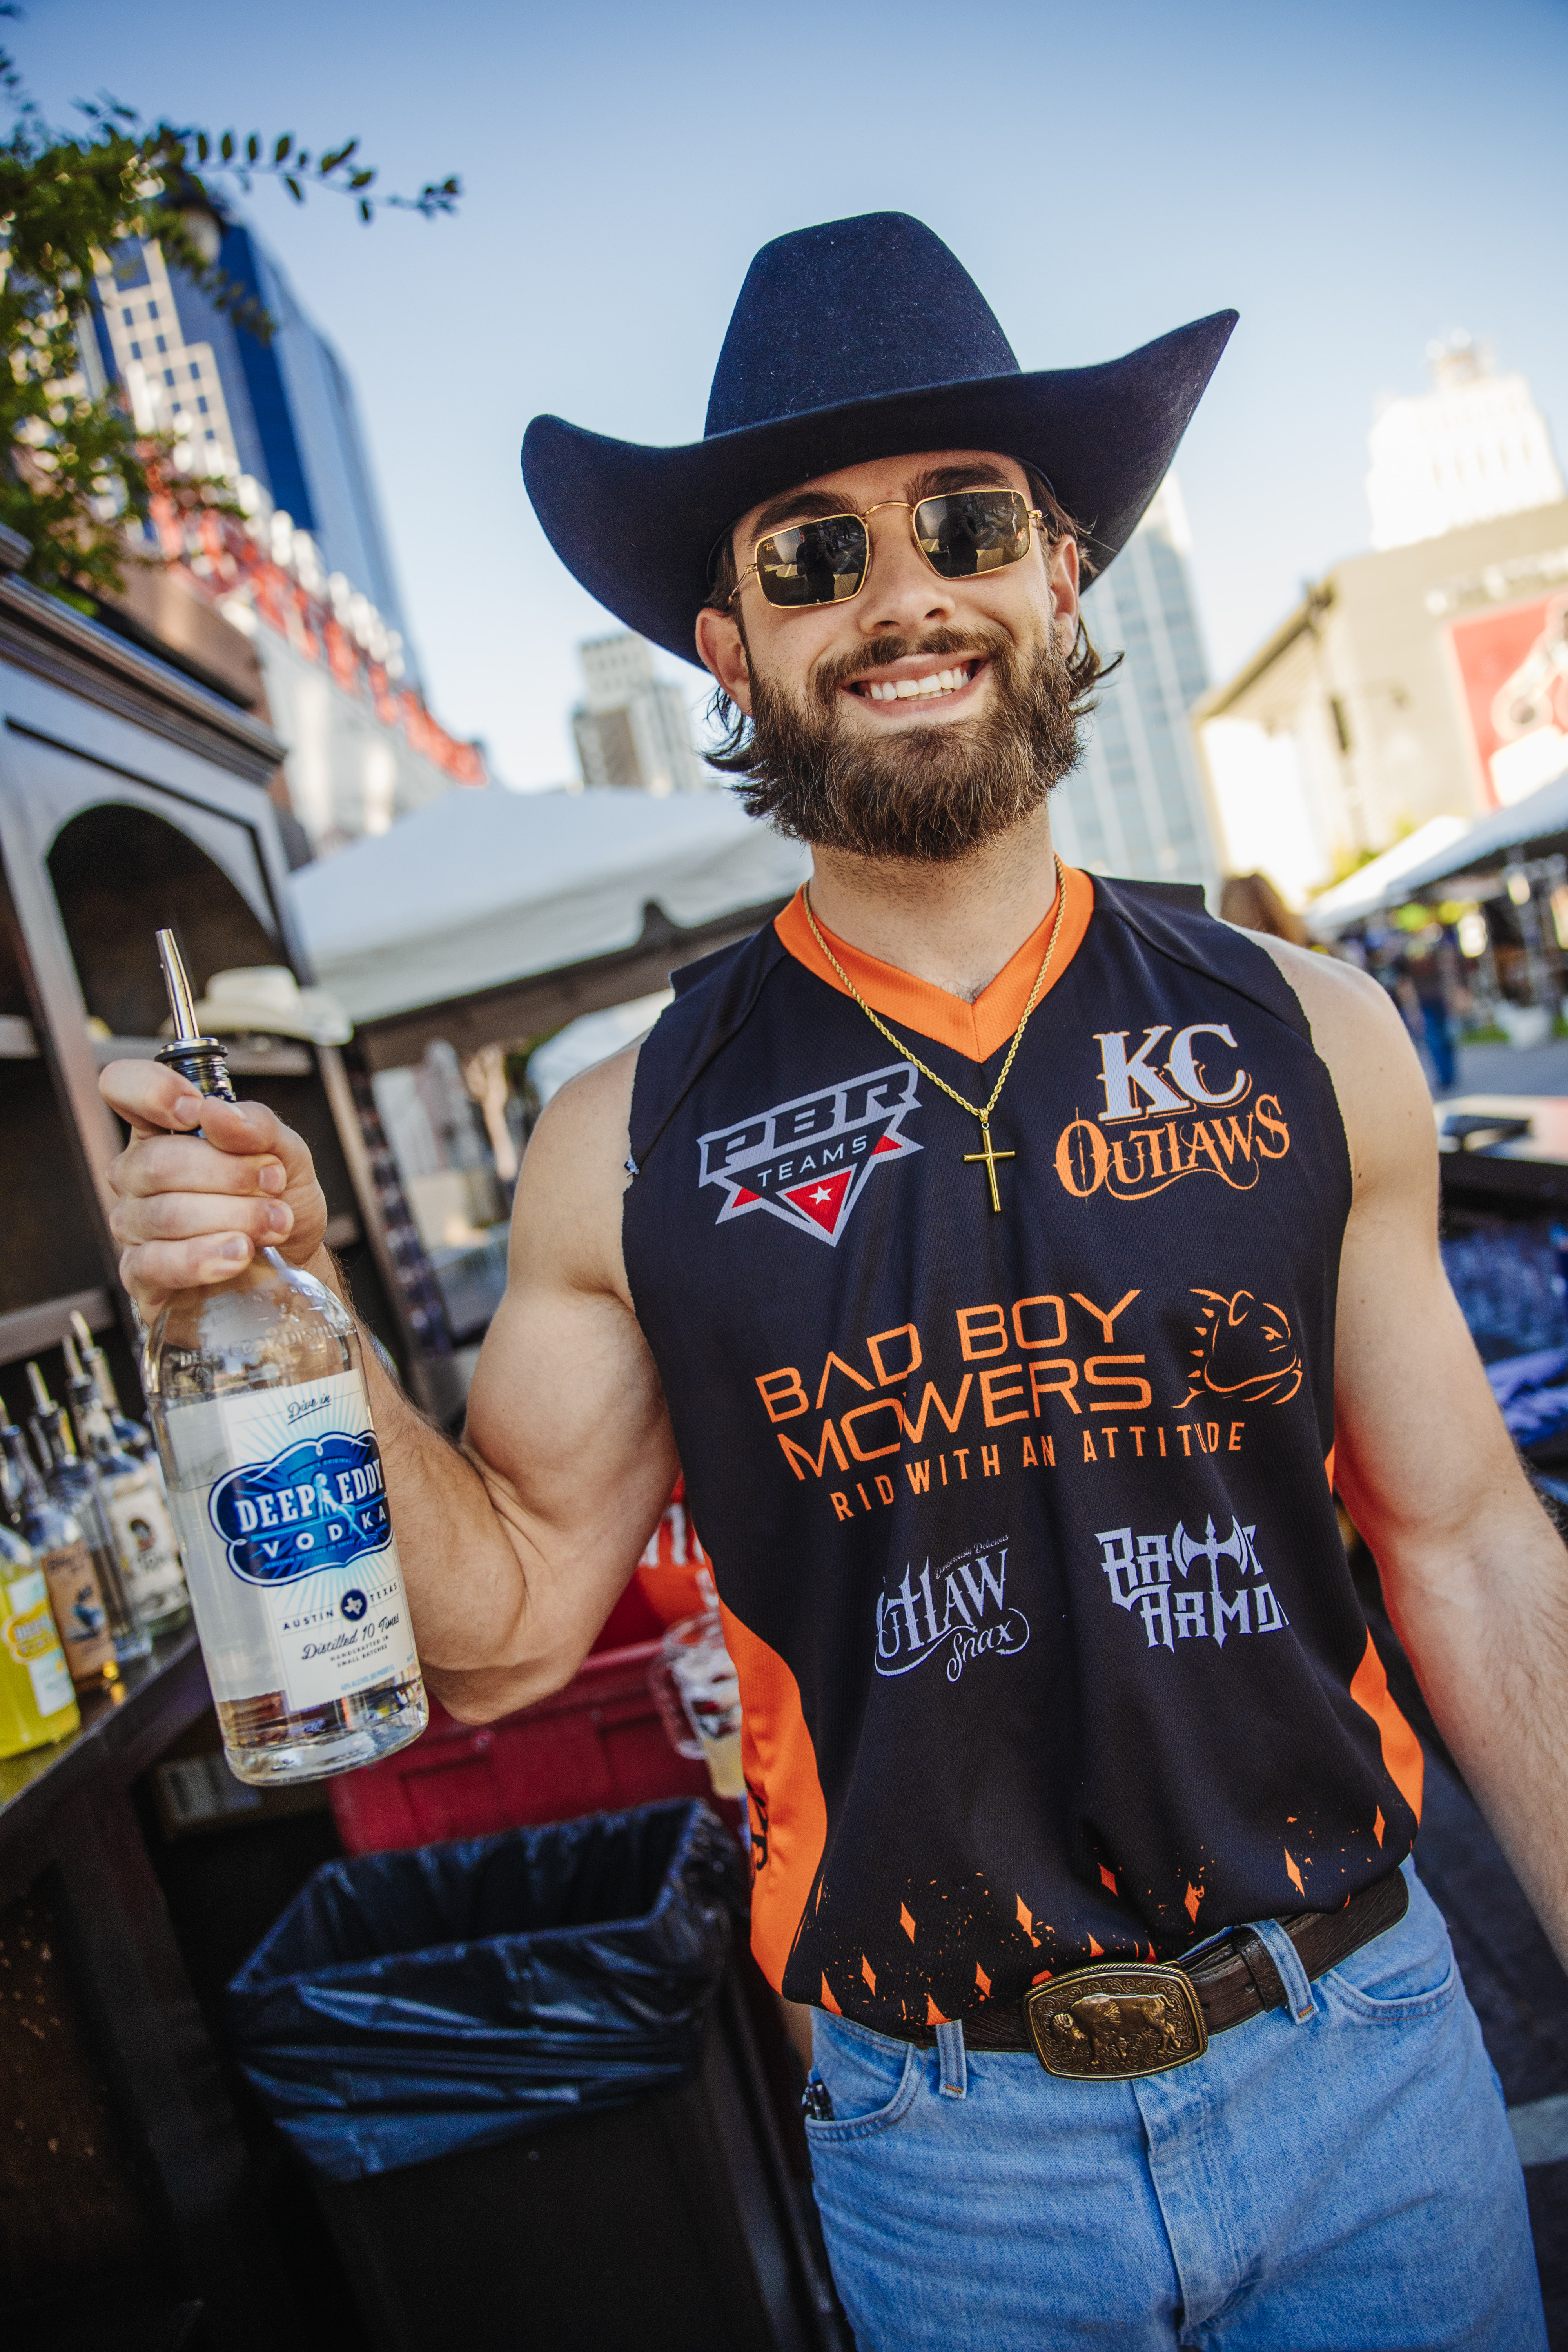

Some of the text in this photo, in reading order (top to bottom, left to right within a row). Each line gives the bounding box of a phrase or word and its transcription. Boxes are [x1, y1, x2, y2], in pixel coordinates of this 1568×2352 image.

[1093, 1023, 1250, 1123] KC
[698, 1061, 919, 1186] PBR
[1053, 1094, 1290, 1201] OUTLAWS
[757, 1135, 867, 1187] TEAMS
[755, 1290, 1142, 1423] BAD BOY
[288, 1393, 332, 1419] Dive in
[777, 1354, 1152, 1481] MOWERS
[234, 1458, 383, 1533] DEEP EDDY
[830, 1475, 894, 1521] RID
[905, 1445, 1001, 1494] WITH
[1023, 1435, 1056, 1467] AN
[262, 1505, 386, 1559] VODKA
[283, 1582, 397, 1630] AUSTIN TEXAS
[301, 1613, 399, 1660] Distilled 10 Times
[1139, 1584, 1290, 1655] ARMO
[330, 1638, 381, 1661] HANDCRAFTED
[337, 1643, 388, 1668] SMALL BATCHES
[947, 1620, 1014, 1682] Snax
